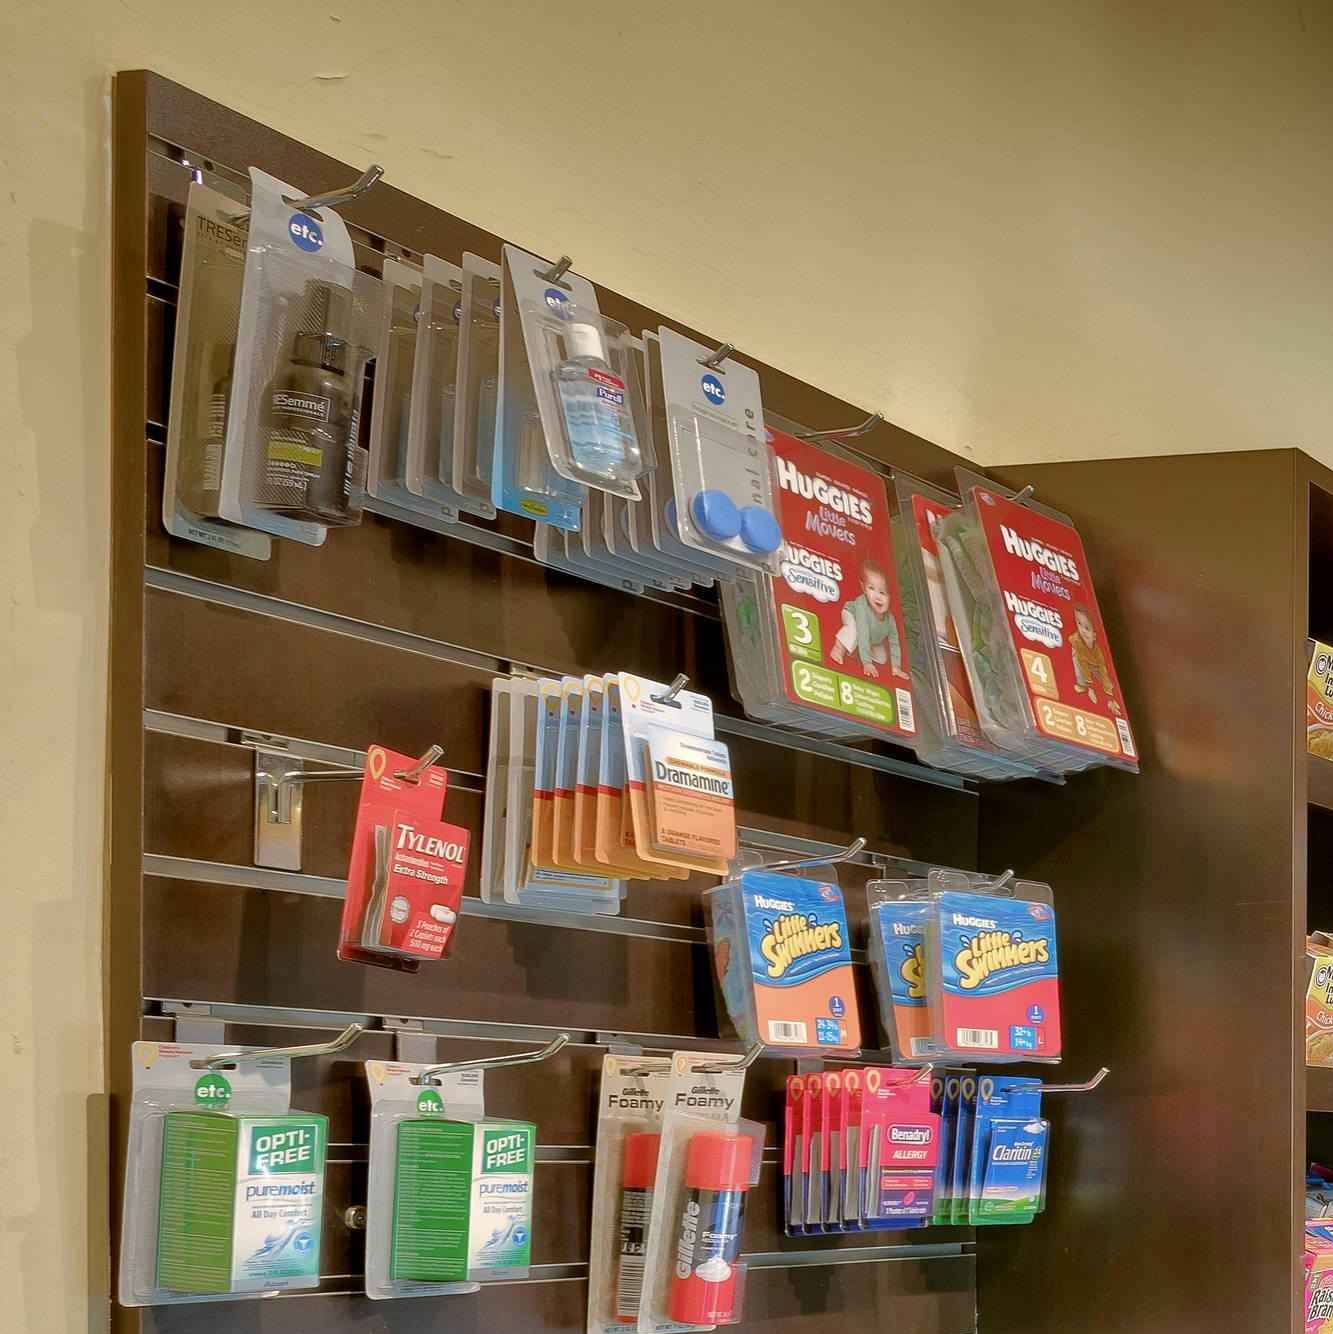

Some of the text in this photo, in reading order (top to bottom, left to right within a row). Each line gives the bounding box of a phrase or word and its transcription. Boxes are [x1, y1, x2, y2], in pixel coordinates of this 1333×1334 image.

[290, 221, 324, 247] etc.
[702, 381, 725, 400] etc.
[776, 456, 873, 525] HUGGIES
[819, 505, 847, 528] Little
[805, 510, 857, 547] Movers
[1000, 523, 1081, 582] HUGGIES
[787, 567, 837, 598] Sensitive
[1004, 590, 1064, 630] HUGGIES
[791, 611, 813, 644] 3
[1020, 617, 1061, 643] Sensitive
[1031, 656, 1048, 684] 4
[655, 761, 731, 796] Dramamine
[396, 823, 466, 865] TYLENOL
[416, 869, 449, 886] Strength
[754, 894, 796, 912] HUGGIES
[773, 913, 808, 941] Little
[952, 913, 998, 930] HUGGIES
[759, 920, 843, 979] Swimmers
[971, 931, 1011, 958] Little
[954, 937, 1049, 991] Swimmers
[197, 1084, 231, 1099] etc.
[608, 1094, 664, 1112] Foamy
[675, 1093, 734, 1111] Foamy
[418, 1100, 443, 1113] etc.
[255, 1129, 310, 1152] OPTI-
[486, 1136, 525, 1154] OPTI-
[891, 1128, 930, 1144] Benadryl
[255, 1146, 310, 1169] FREE
[486, 1150, 525, 1169] FREE
[893, 1150, 928, 1160] ALLERGY
[992, 1145, 1031, 1161] Claritin
[264, 1207, 307, 1221] Day Comfort
[675, 1201, 700, 1280] Gillette
[1308, 1302, 1333, 1321] Bran
